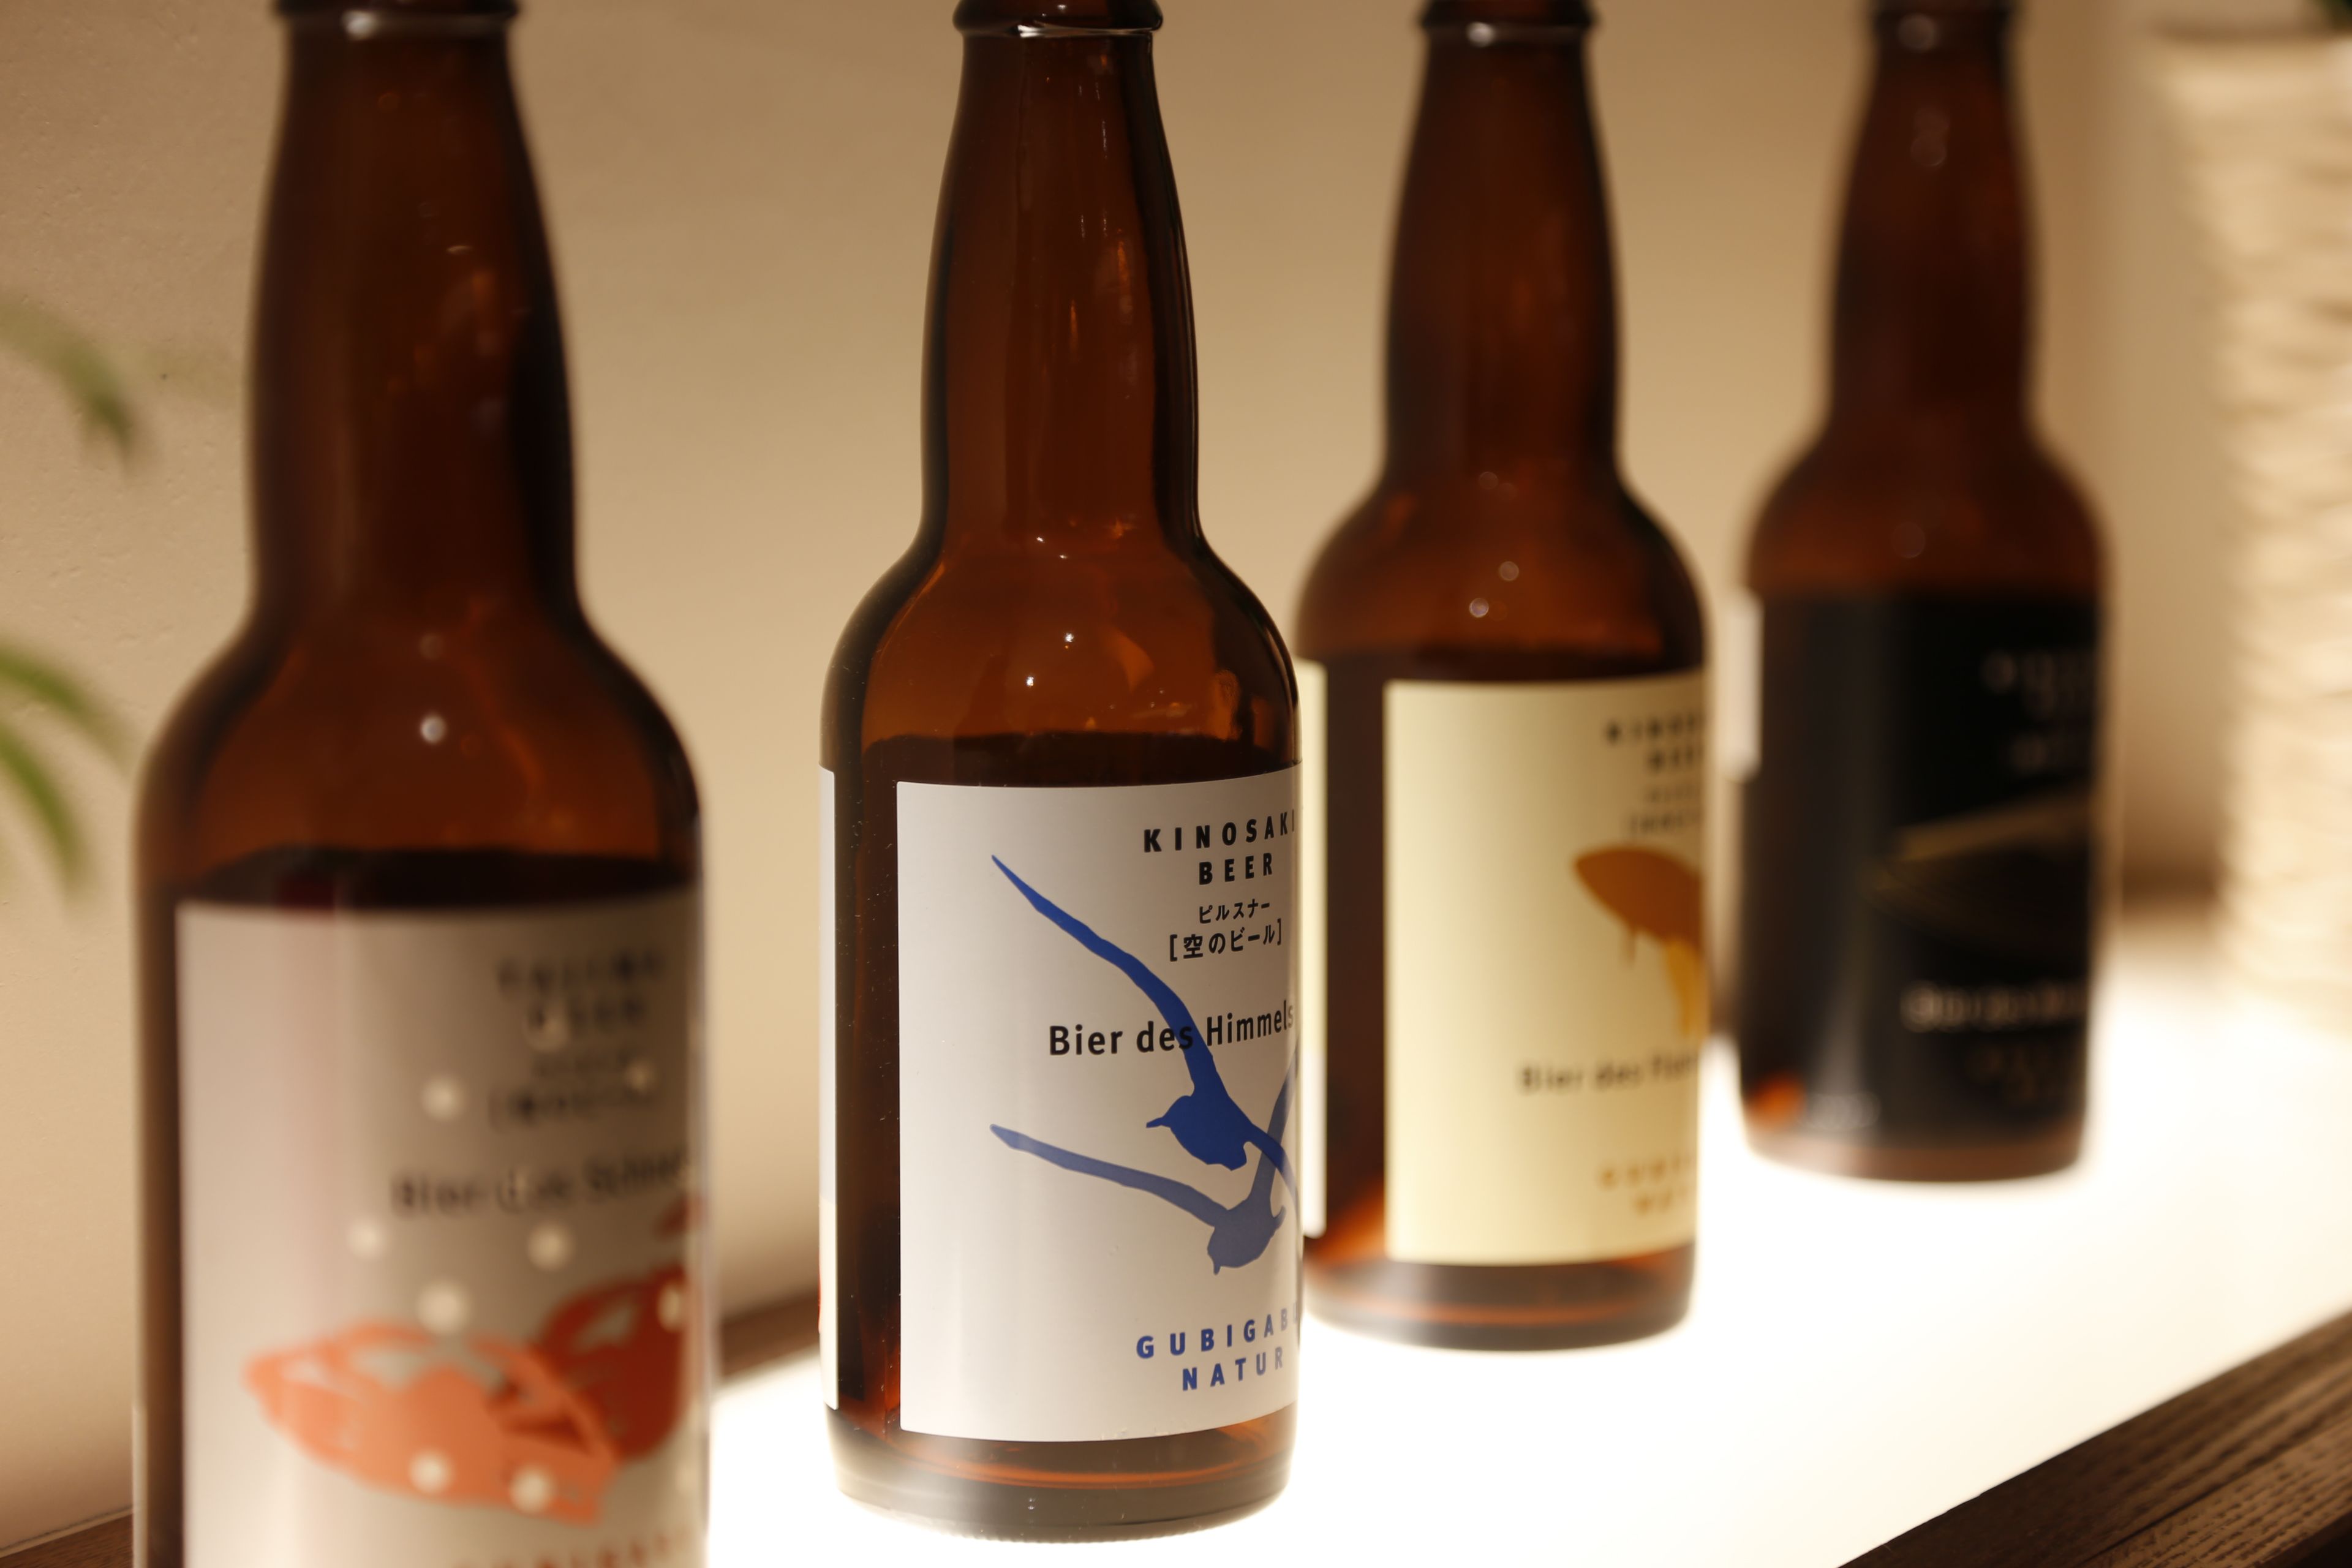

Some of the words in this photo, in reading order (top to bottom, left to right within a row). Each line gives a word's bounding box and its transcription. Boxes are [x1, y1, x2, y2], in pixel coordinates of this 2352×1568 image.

[1143, 808, 1295, 853] KINOSAKI
[1198, 852, 1273, 886] BEER
[1199, 898, 1271, 924] ピルスナー
[1049, 1023, 1123, 1056] Bier
[1136, 1020, 1194, 1052] des
[1206, 999, 1294, 1047] Himmels
